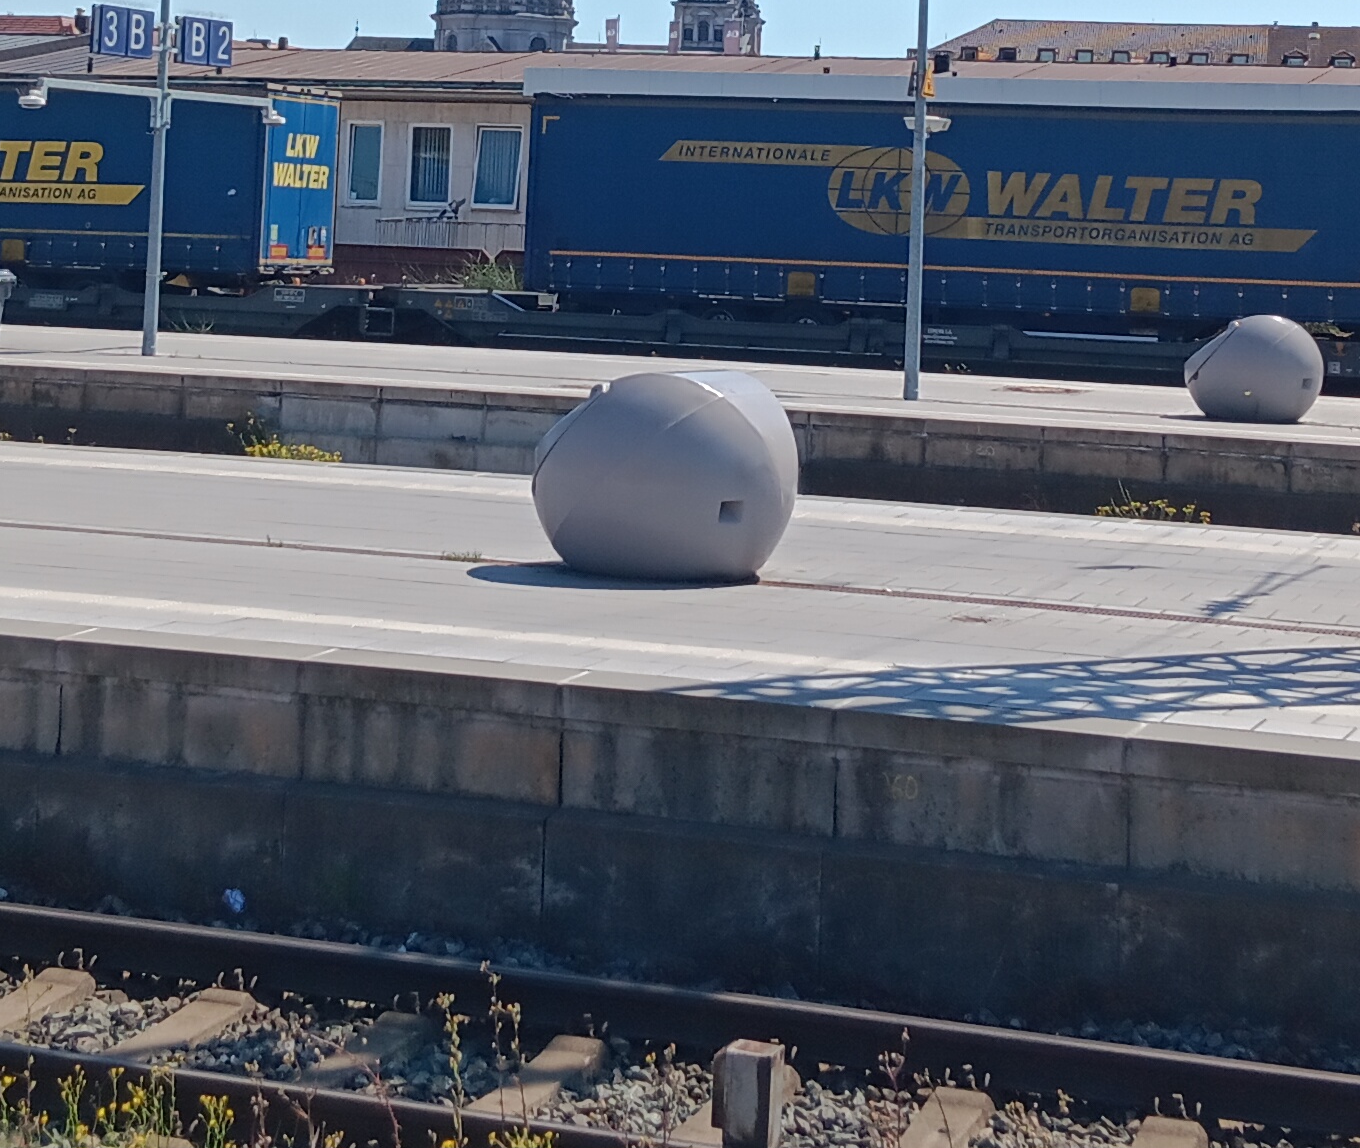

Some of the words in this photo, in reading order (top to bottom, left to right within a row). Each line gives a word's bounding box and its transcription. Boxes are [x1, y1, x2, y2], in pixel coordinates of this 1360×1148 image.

[104, 10, 118, 47] 3
[130, 13, 145, 50] B
[191, 21, 206, 56] B
[217, 26, 230, 60] 2
[285, 133, 320, 159] LKW
[678, 144, 832, 162] INTERNATIONALE
[273, 162, 329, 190] WALTER
[77, 187, 97, 201] AG
[836, 170, 962, 213] LKW
[986, 170, 1263, 225] WALTER
[985, 222, 1223, 246] TRANSPORTORGANISATION
[1229, 232, 1254, 246] AG
